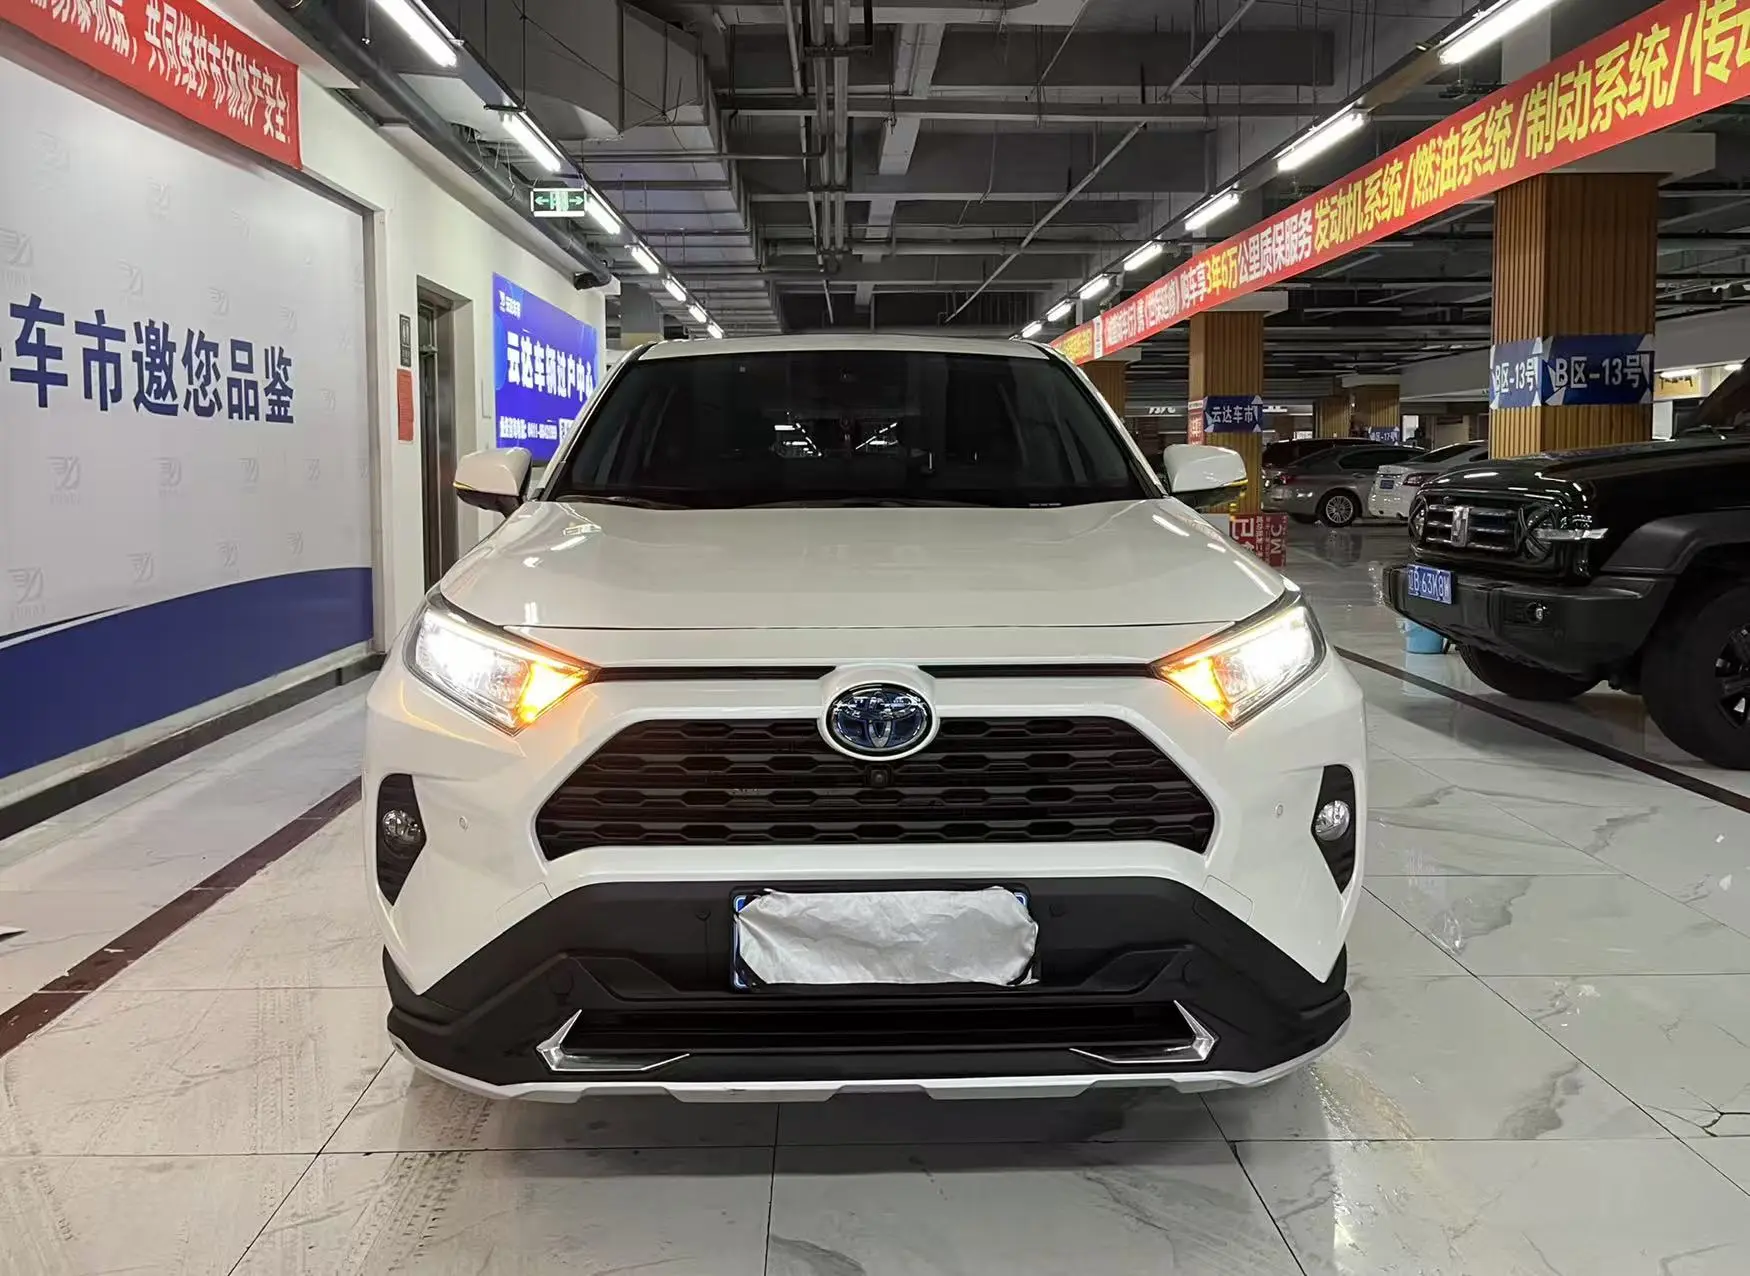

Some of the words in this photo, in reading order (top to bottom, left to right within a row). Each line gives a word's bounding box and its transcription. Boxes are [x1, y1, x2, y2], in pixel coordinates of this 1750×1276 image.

[0, 292, 294, 424] 车市邀您品鉴
[1554, 353, 1642, 390] B区-13号
